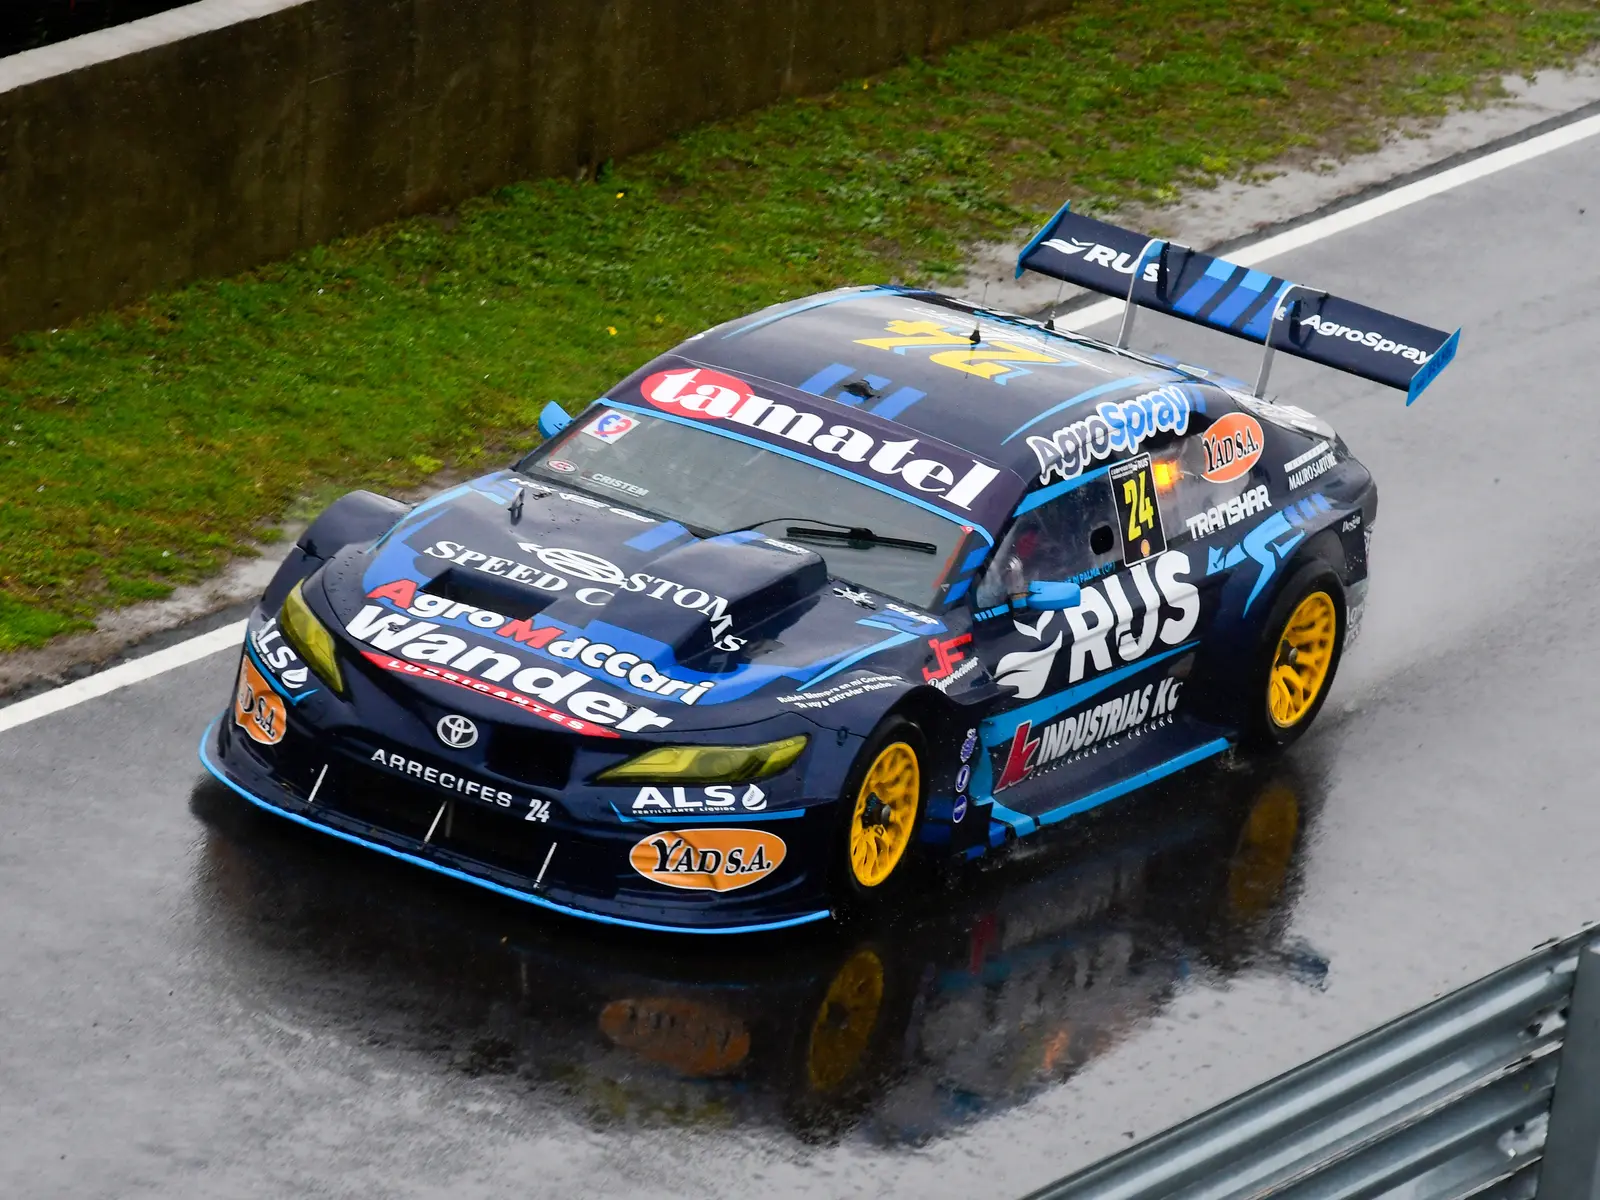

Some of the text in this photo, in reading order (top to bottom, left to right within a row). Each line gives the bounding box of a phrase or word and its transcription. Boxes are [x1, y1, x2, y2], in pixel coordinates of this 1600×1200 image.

[1083, 243, 1167, 282] RUS
[1301, 314, 1434, 366] AgroSpray
[650, 368, 1001, 512] tamatel
[1026, 385, 1191, 486] AgroSpray
[1203, 435, 1234, 473] YAD
[1235, 427, 1259, 459] S.A.
[1122, 470, 1154, 542] 24
[423, 541, 748, 651] SPEED CSTOMS
[1063, 550, 1200, 684] RUS
[345, 605, 674, 732] Wander
[1036, 684, 1154, 766] INDUSTRIAS
[371, 749, 552, 823] ARRECIFES 24
[632, 785, 736, 810] ALS
[651, 837, 772, 876] YAD S.A.
